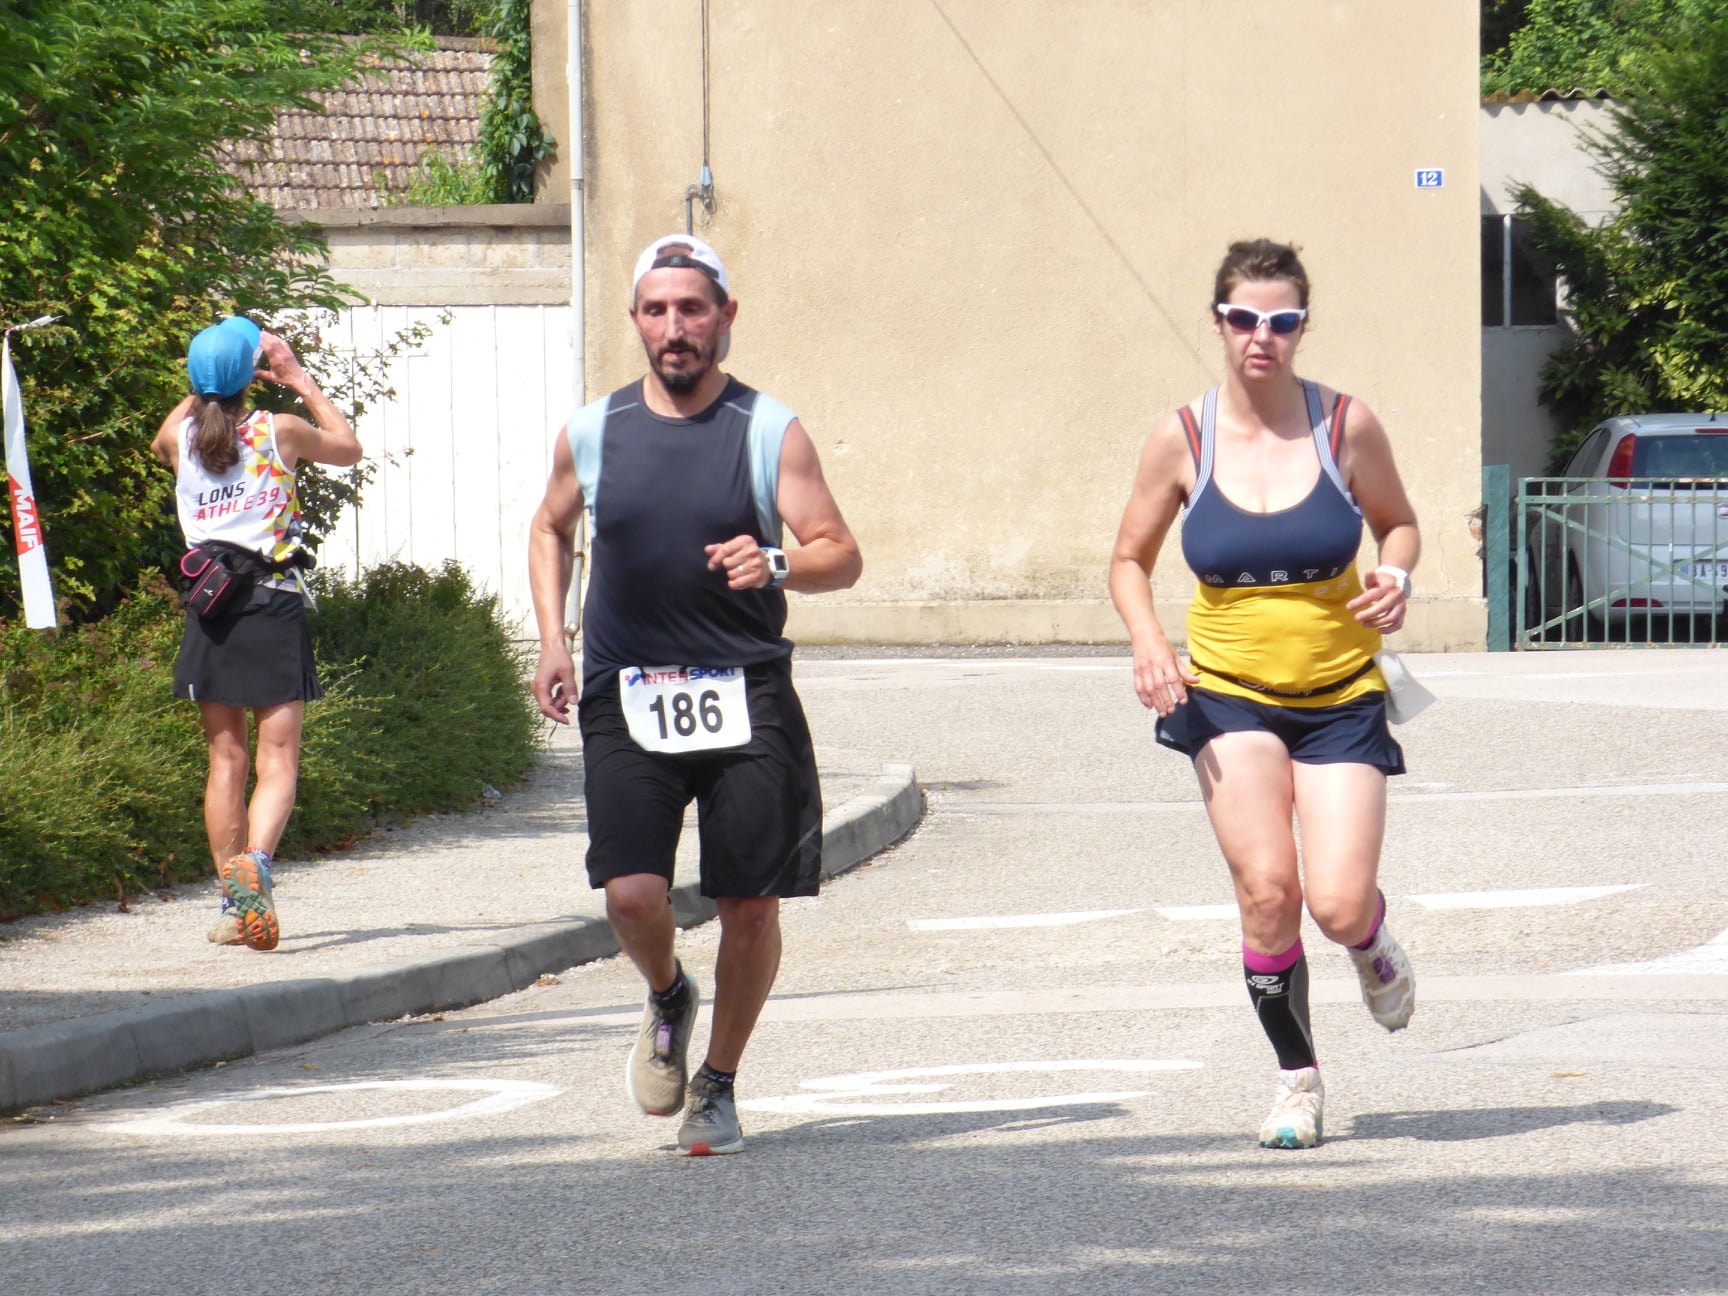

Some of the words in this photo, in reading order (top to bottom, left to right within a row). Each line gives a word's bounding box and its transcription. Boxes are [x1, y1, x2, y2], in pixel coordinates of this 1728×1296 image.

[1420, 171, 1438, 186] 12
[197, 494, 256, 521] ATHLE
[257, 486, 281, 507] 39
[199, 481, 246, 506] LONS
[14, 489, 39, 549] MAIF
[650, 689, 723, 740] 186
